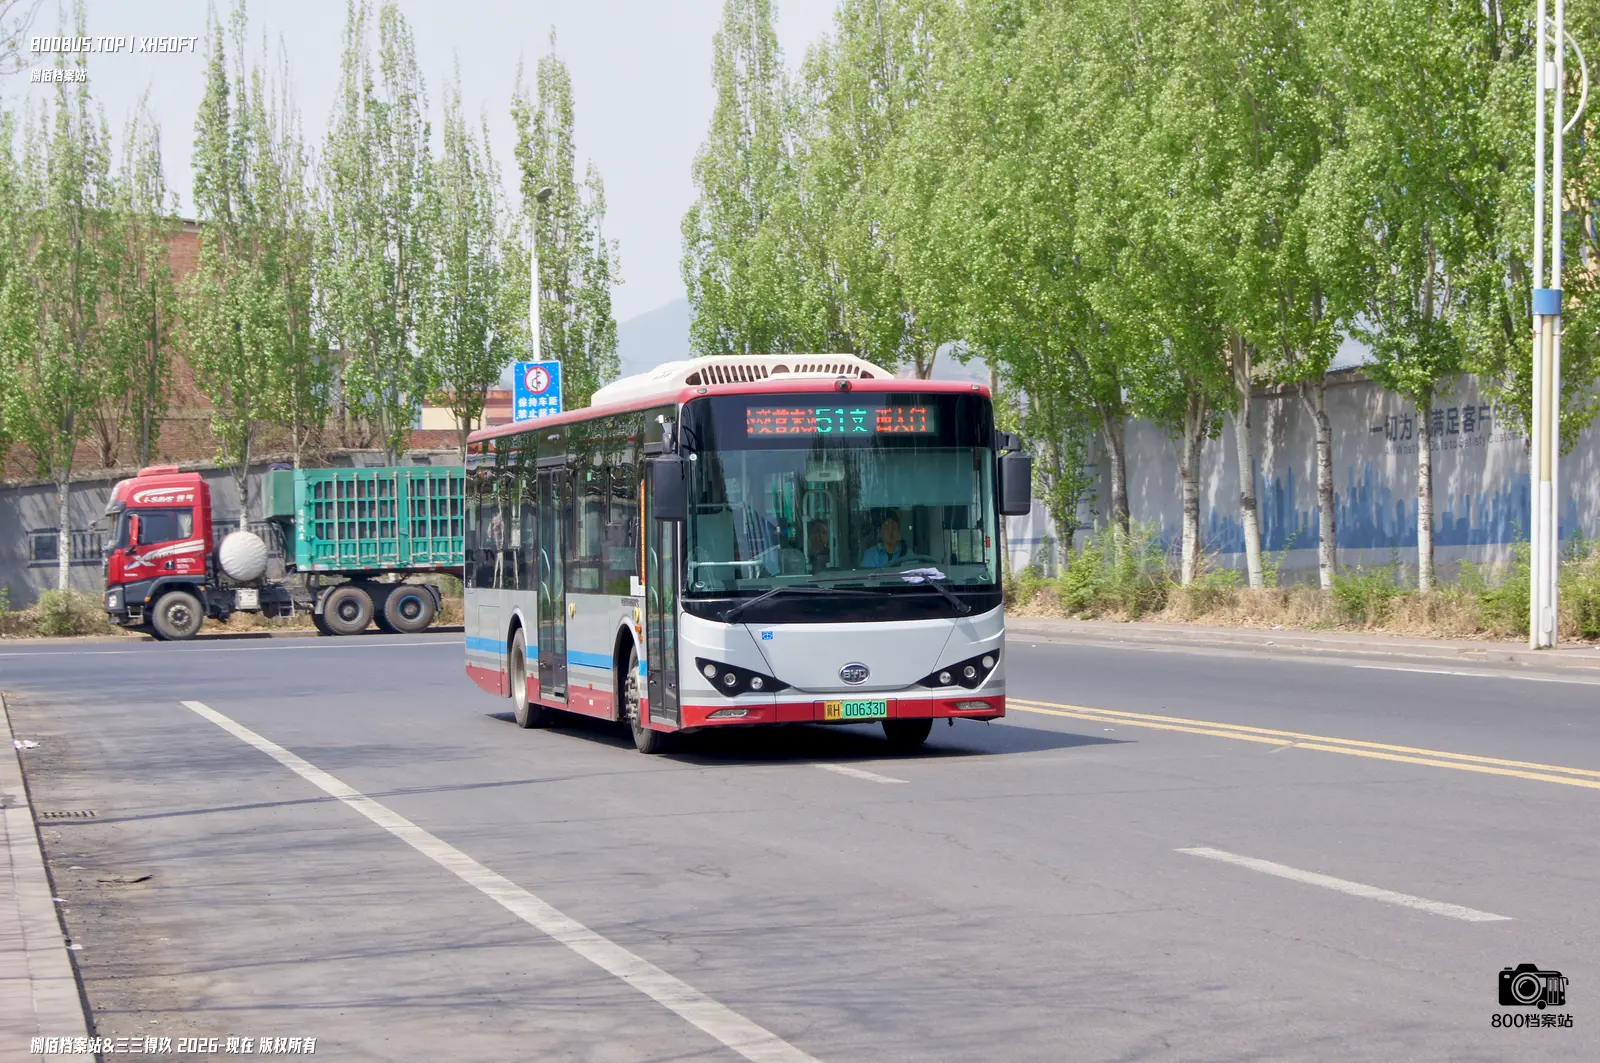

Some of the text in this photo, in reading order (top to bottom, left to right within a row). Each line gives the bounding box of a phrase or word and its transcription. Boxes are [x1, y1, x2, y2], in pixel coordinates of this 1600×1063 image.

[518, 396, 558, 408] 保持车距
[842, 669, 867, 679] BYD
[845, 702, 886, 716] 00633D
